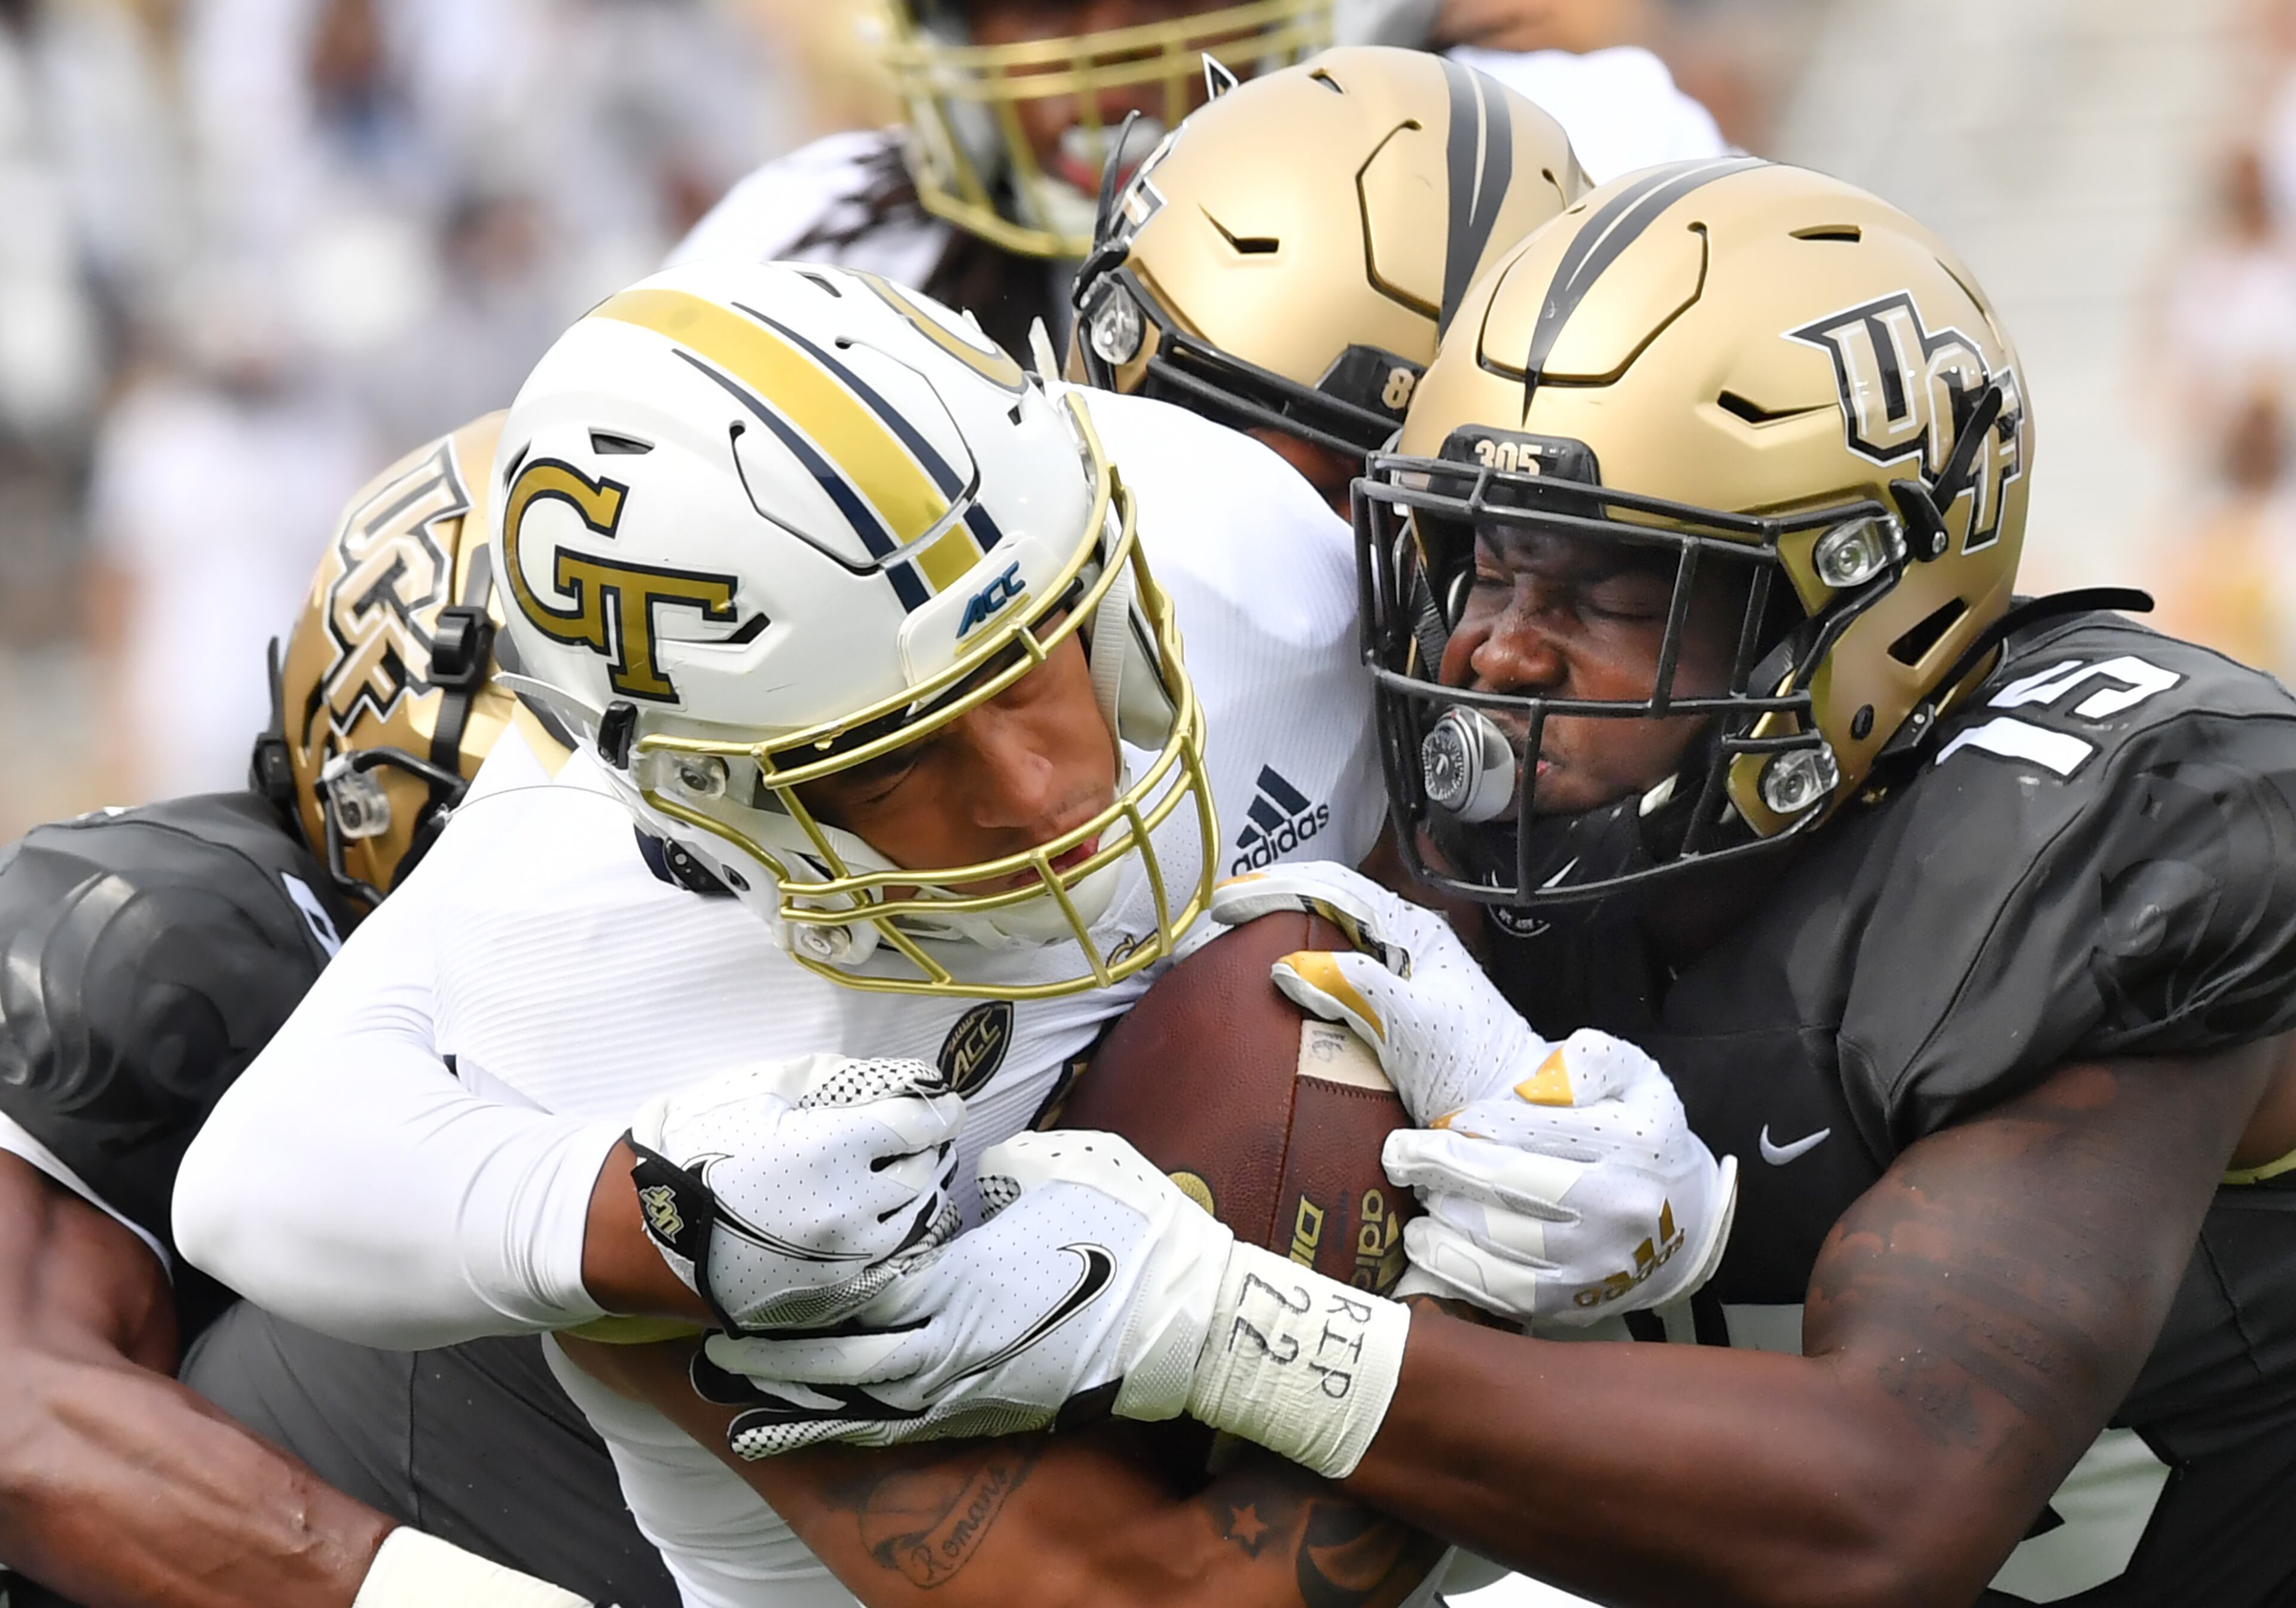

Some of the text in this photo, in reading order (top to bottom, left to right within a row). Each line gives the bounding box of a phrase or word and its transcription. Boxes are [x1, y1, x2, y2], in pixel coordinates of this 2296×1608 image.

[1381, 366, 1419, 411] 8
[1779, 288, 2025, 556] UCF
[1474, 439, 1543, 476] 305
[322, 433, 474, 736] UCF
[502, 457, 739, 705] GT
[955, 560, 1027, 640] ACC
[1231, 803, 1329, 877] adidas
[950, 1007, 1002, 1089] ACC
[639, 1184, 685, 1245] UCF
[1289, 1194, 1325, 1269] DI
[1228, 1272, 1311, 1365] 22
[1308, 1294, 1373, 1399] RIP
